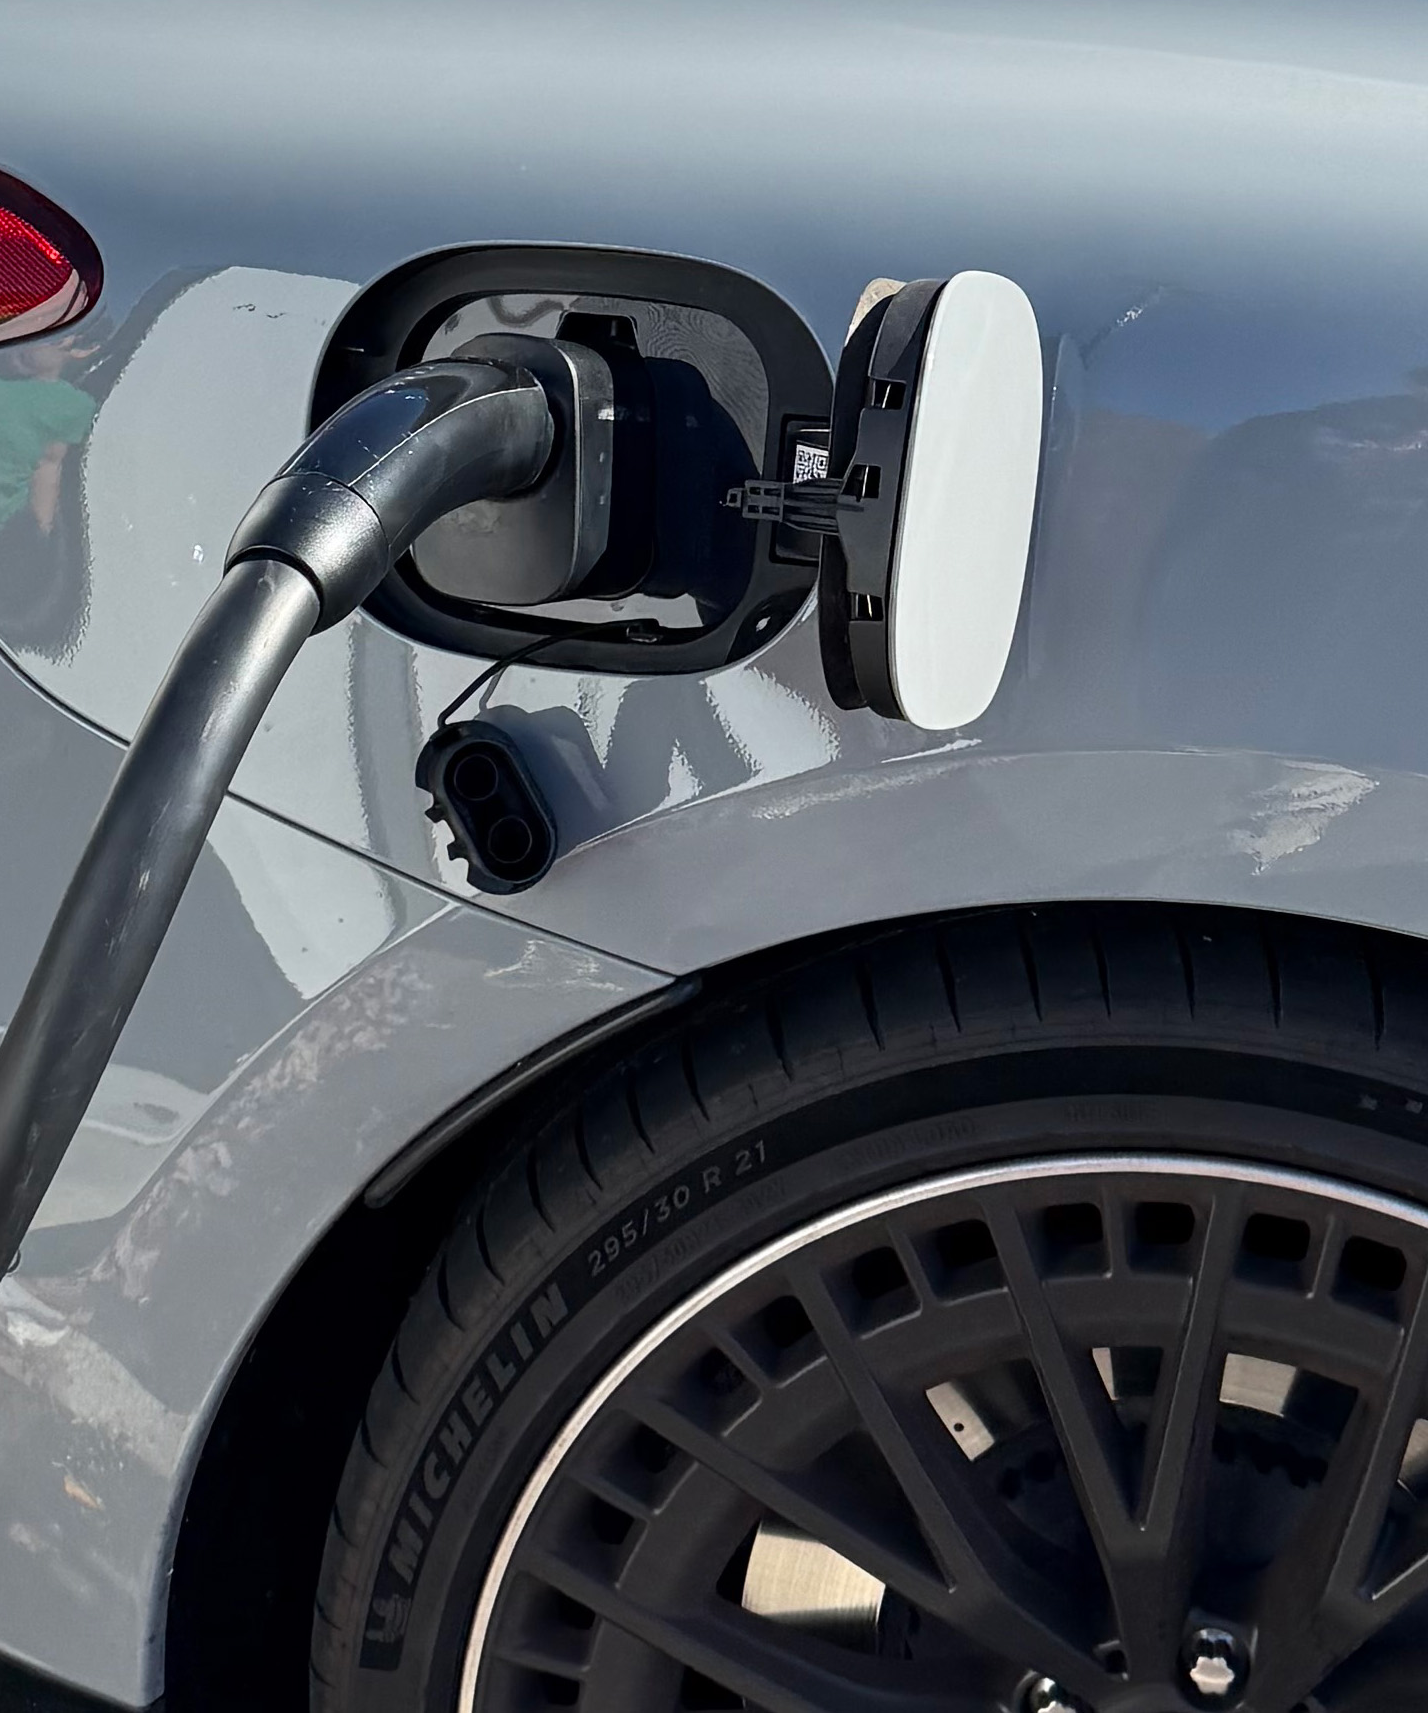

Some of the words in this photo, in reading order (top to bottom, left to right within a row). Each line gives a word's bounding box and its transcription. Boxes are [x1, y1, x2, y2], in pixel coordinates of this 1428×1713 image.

[587, 1184, 690, 1277] 295/30
[702, 1165, 723, 1194] R
[734, 1139, 766, 1176] 21
[388, 1282, 570, 1585] MICHELIN
